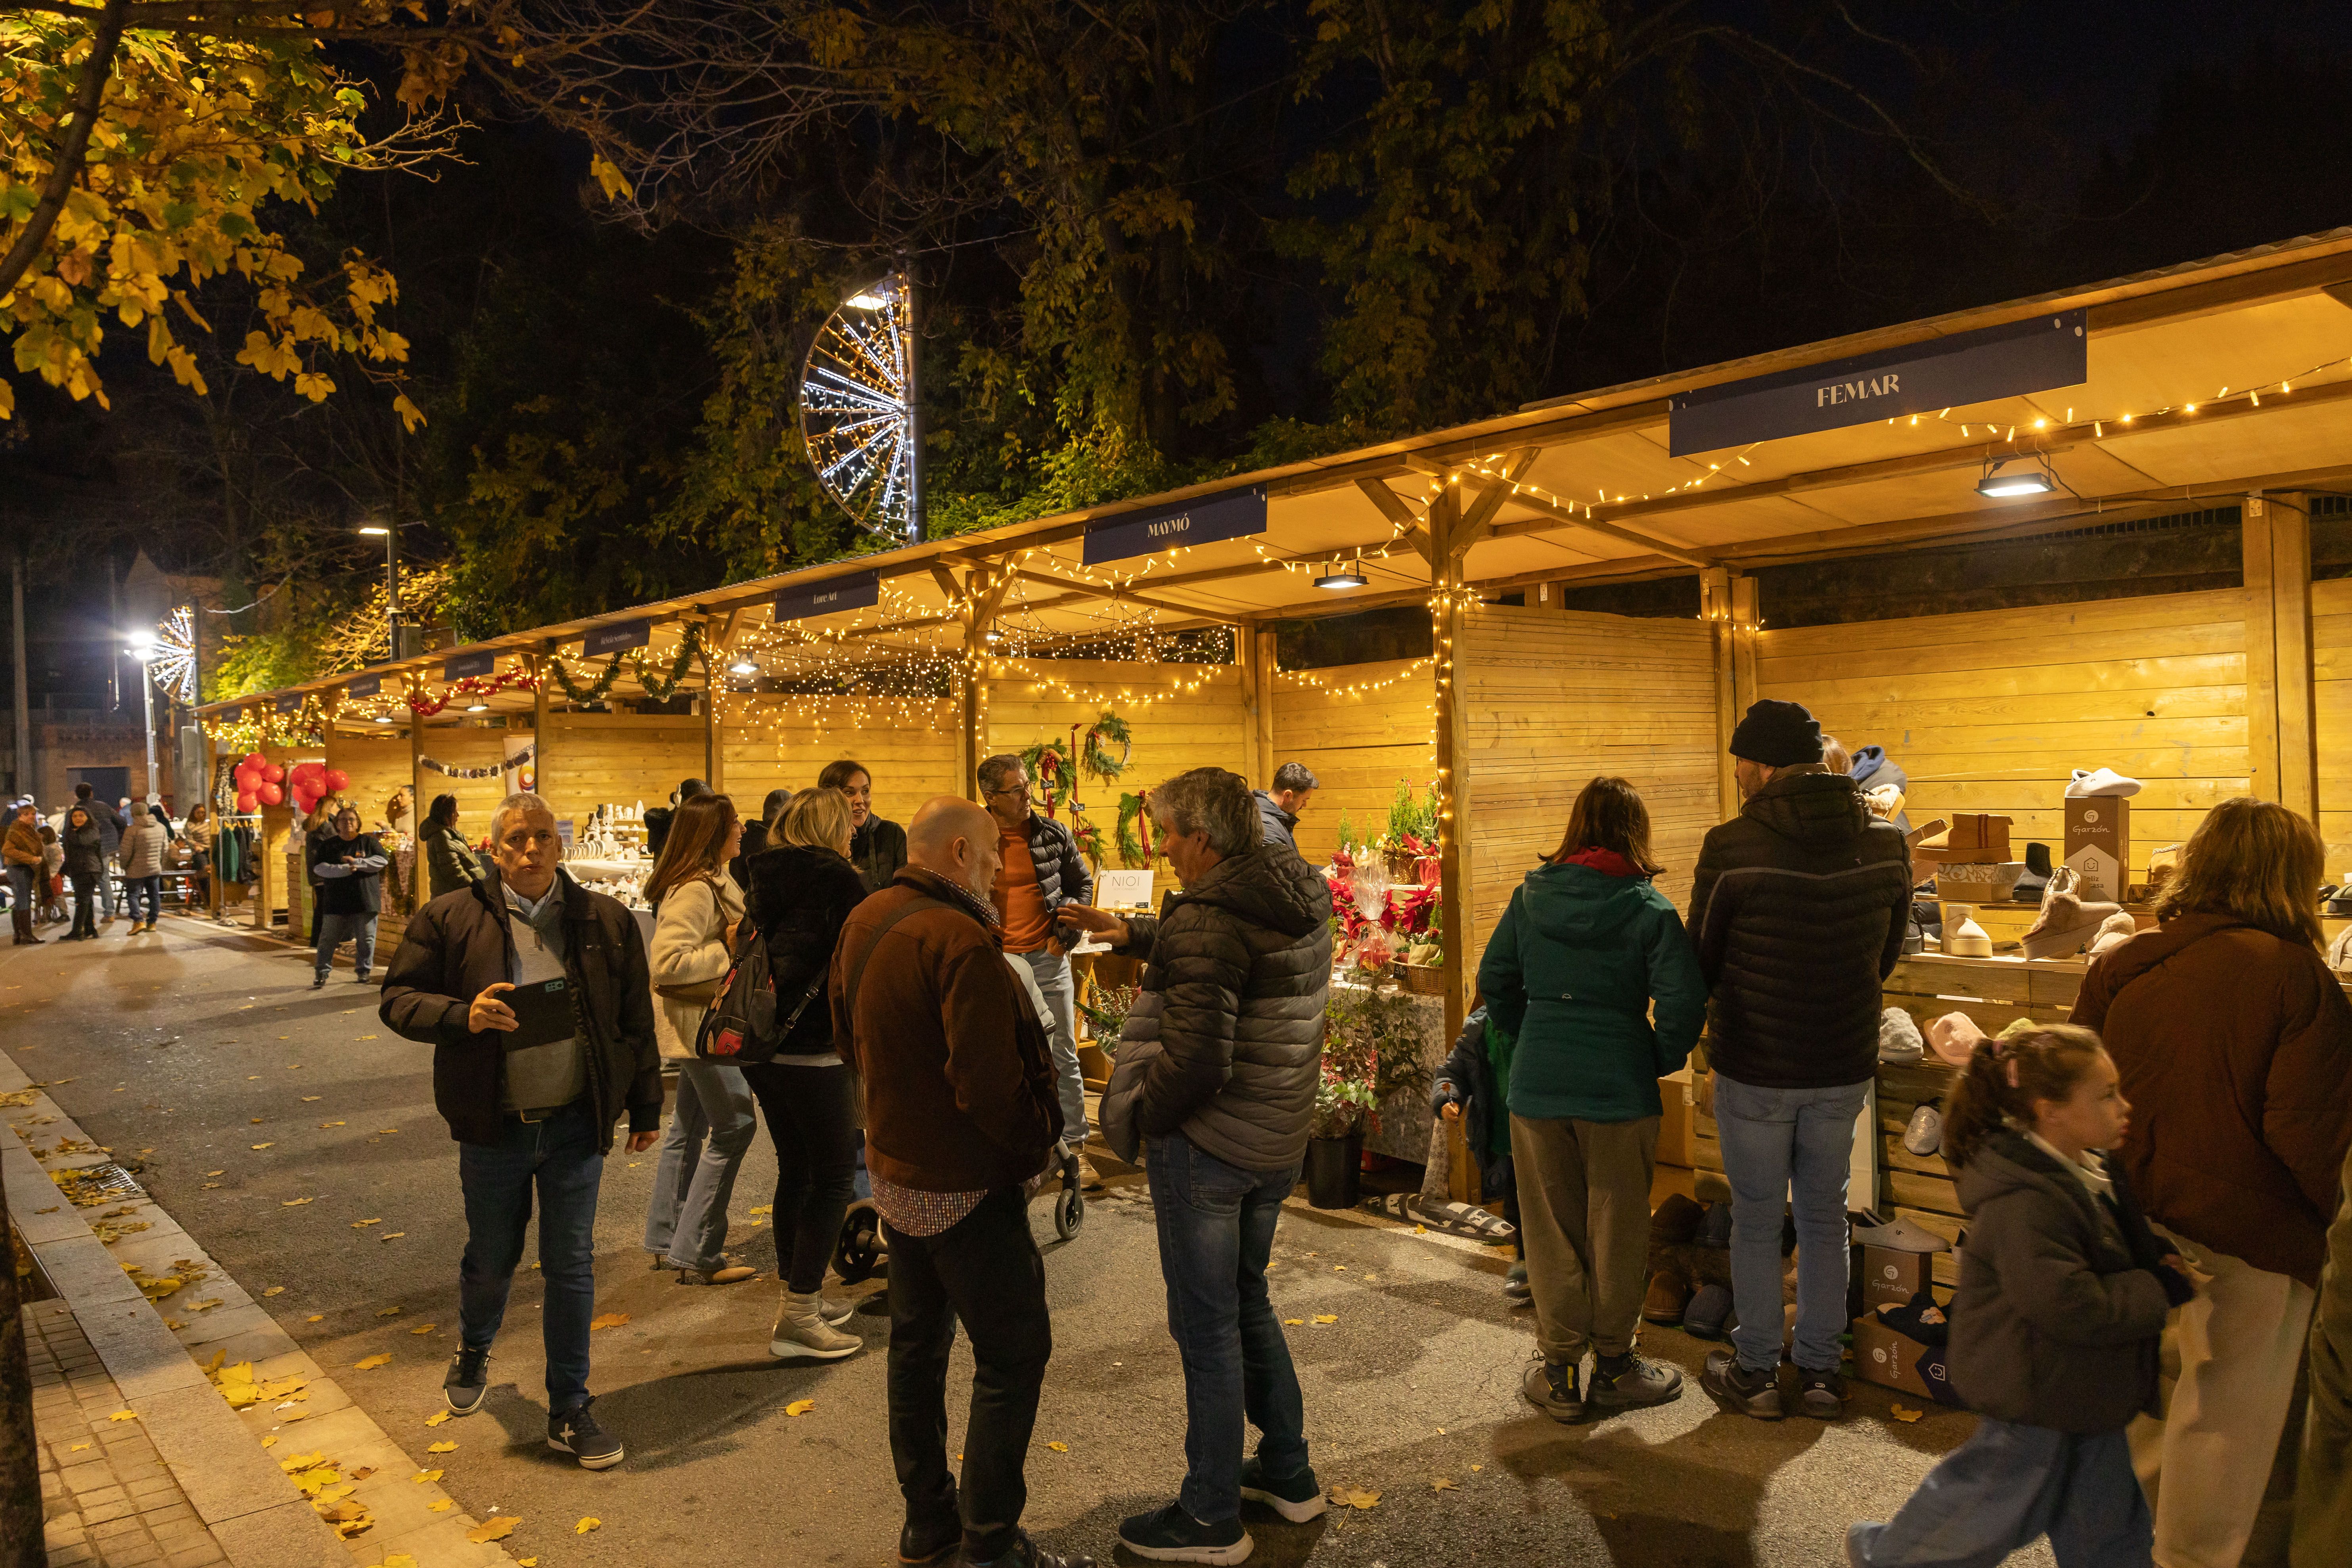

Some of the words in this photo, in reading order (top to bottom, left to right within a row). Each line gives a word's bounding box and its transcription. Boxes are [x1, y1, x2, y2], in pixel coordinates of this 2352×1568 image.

[1817, 374, 1899, 408] FEMAR
[1147, 512, 1190, 538] MAYMÓ
[2072, 825, 2111, 835] Garzón
[1112, 876, 1140, 886] NIOI
[1872, 1279, 1910, 1294] Garzón
[1890, 1340, 1901, 1379] Garzón
